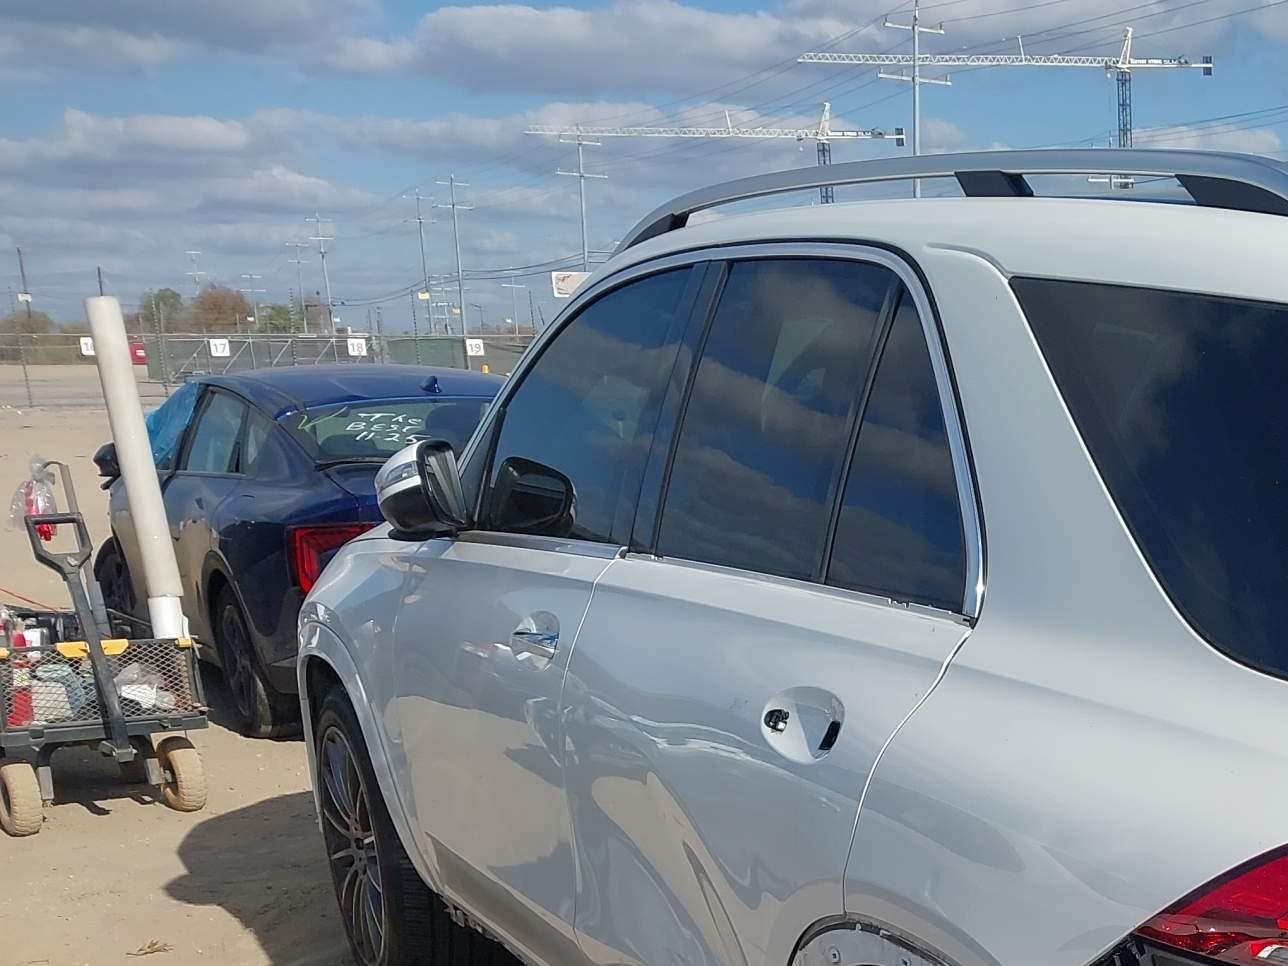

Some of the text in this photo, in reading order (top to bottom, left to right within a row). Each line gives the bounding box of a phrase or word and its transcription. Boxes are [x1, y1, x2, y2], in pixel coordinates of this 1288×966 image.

[213, 343, 226, 353] 17
[350, 342, 364, 353] 18
[469, 342, 482, 353] 19
